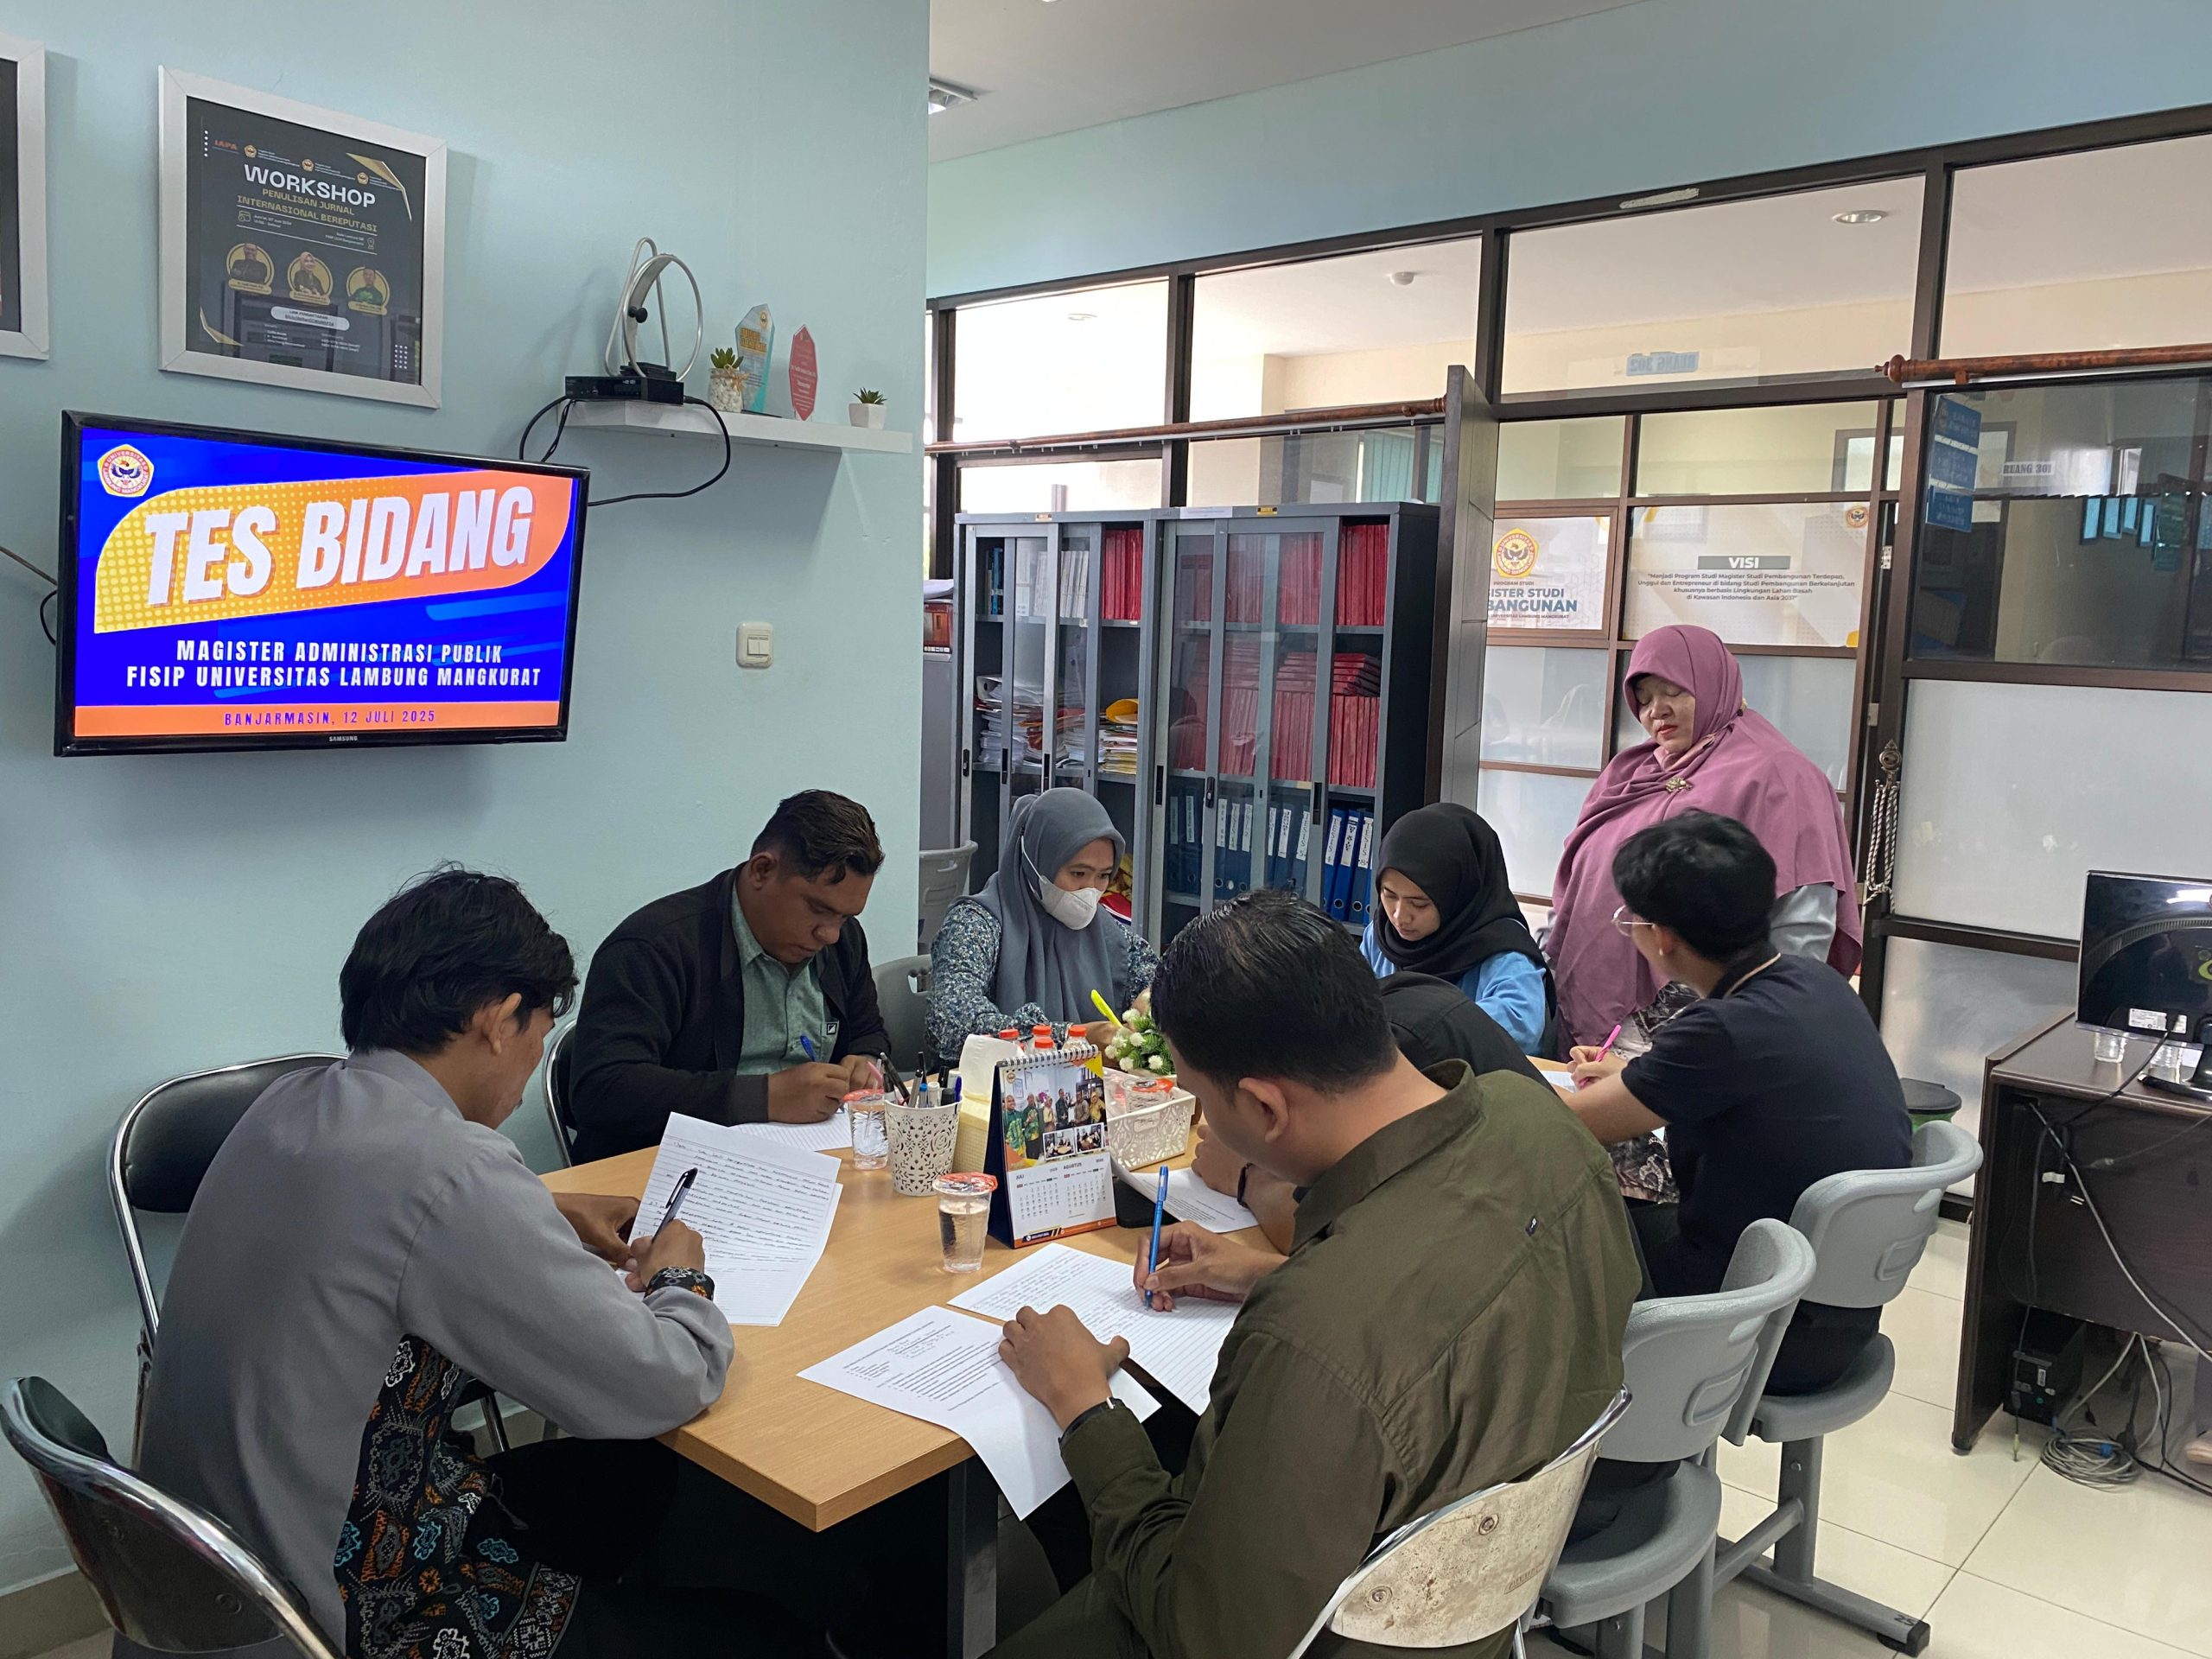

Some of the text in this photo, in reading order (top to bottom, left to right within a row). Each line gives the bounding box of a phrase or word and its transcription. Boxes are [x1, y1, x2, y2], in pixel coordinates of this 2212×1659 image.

[244, 164, 376, 208] WORKSHOP
[237, 195, 378, 232] INTERNASIONAL BEREPUTASI
[262, 188, 355, 216] PENULISAN JURNAL
[2003, 464, 2033, 474] RUANG
[144, 486, 534, 606] TES BIDANG
[1728, 557, 1759, 569] VISI
[1489, 588, 1565, 598] ISTER STUDI
[176, 639, 502, 664] MAGISTER ADMINISTRASI PUBLIK
[126, 665, 541, 688] FISIP UNIVERSITAS LAMBUNG MANGKURAT
[224, 709, 435, 728] BANJARMASIN, 12 JULI 2025
